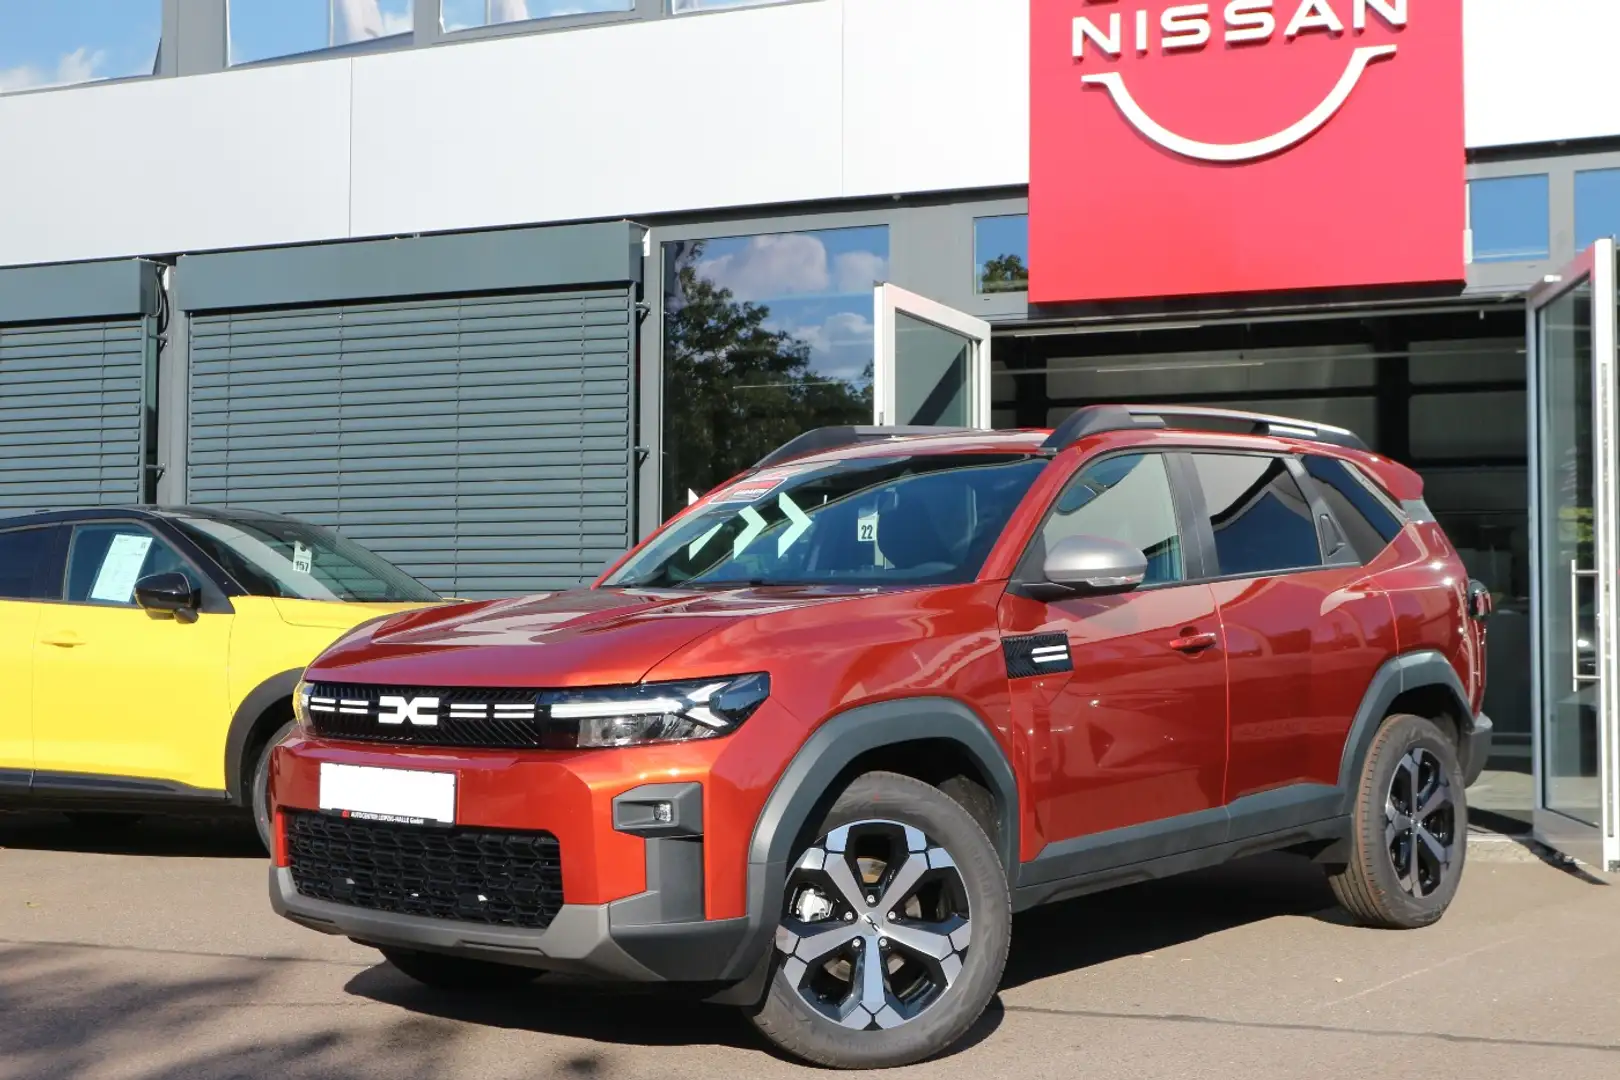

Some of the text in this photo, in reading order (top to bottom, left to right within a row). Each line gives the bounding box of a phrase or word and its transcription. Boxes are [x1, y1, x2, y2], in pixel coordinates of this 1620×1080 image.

[1072, 0, 1408, 57] NISSAN
[861, 525, 873, 539] 22
[296, 561, 309, 571] 157
